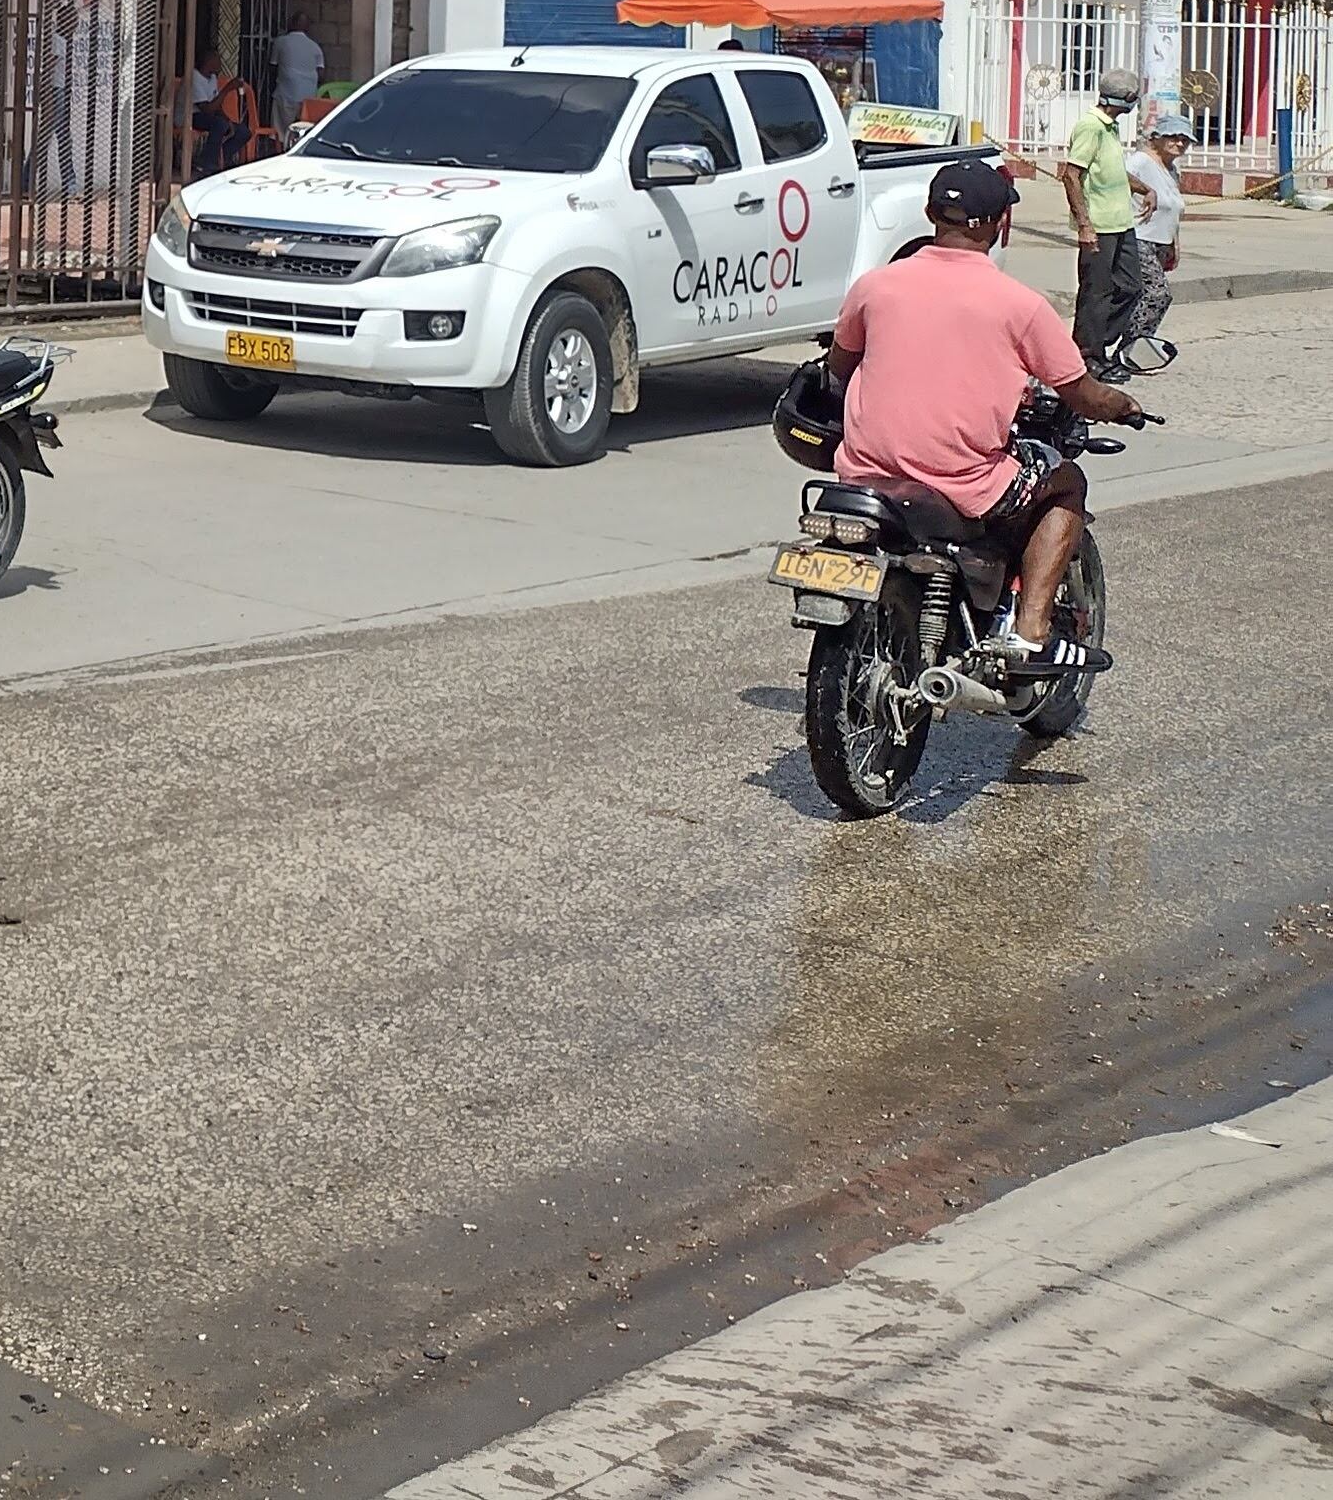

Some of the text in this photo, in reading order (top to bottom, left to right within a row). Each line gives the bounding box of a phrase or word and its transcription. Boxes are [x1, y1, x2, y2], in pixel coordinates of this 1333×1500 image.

[229, 175, 453, 201] CARACOL
[673, 247, 803, 304] CARACOL
[698, 294, 778, 327] RADIO
[261, 340, 291, 364] 503
[780, 553, 827, 581] IGN
